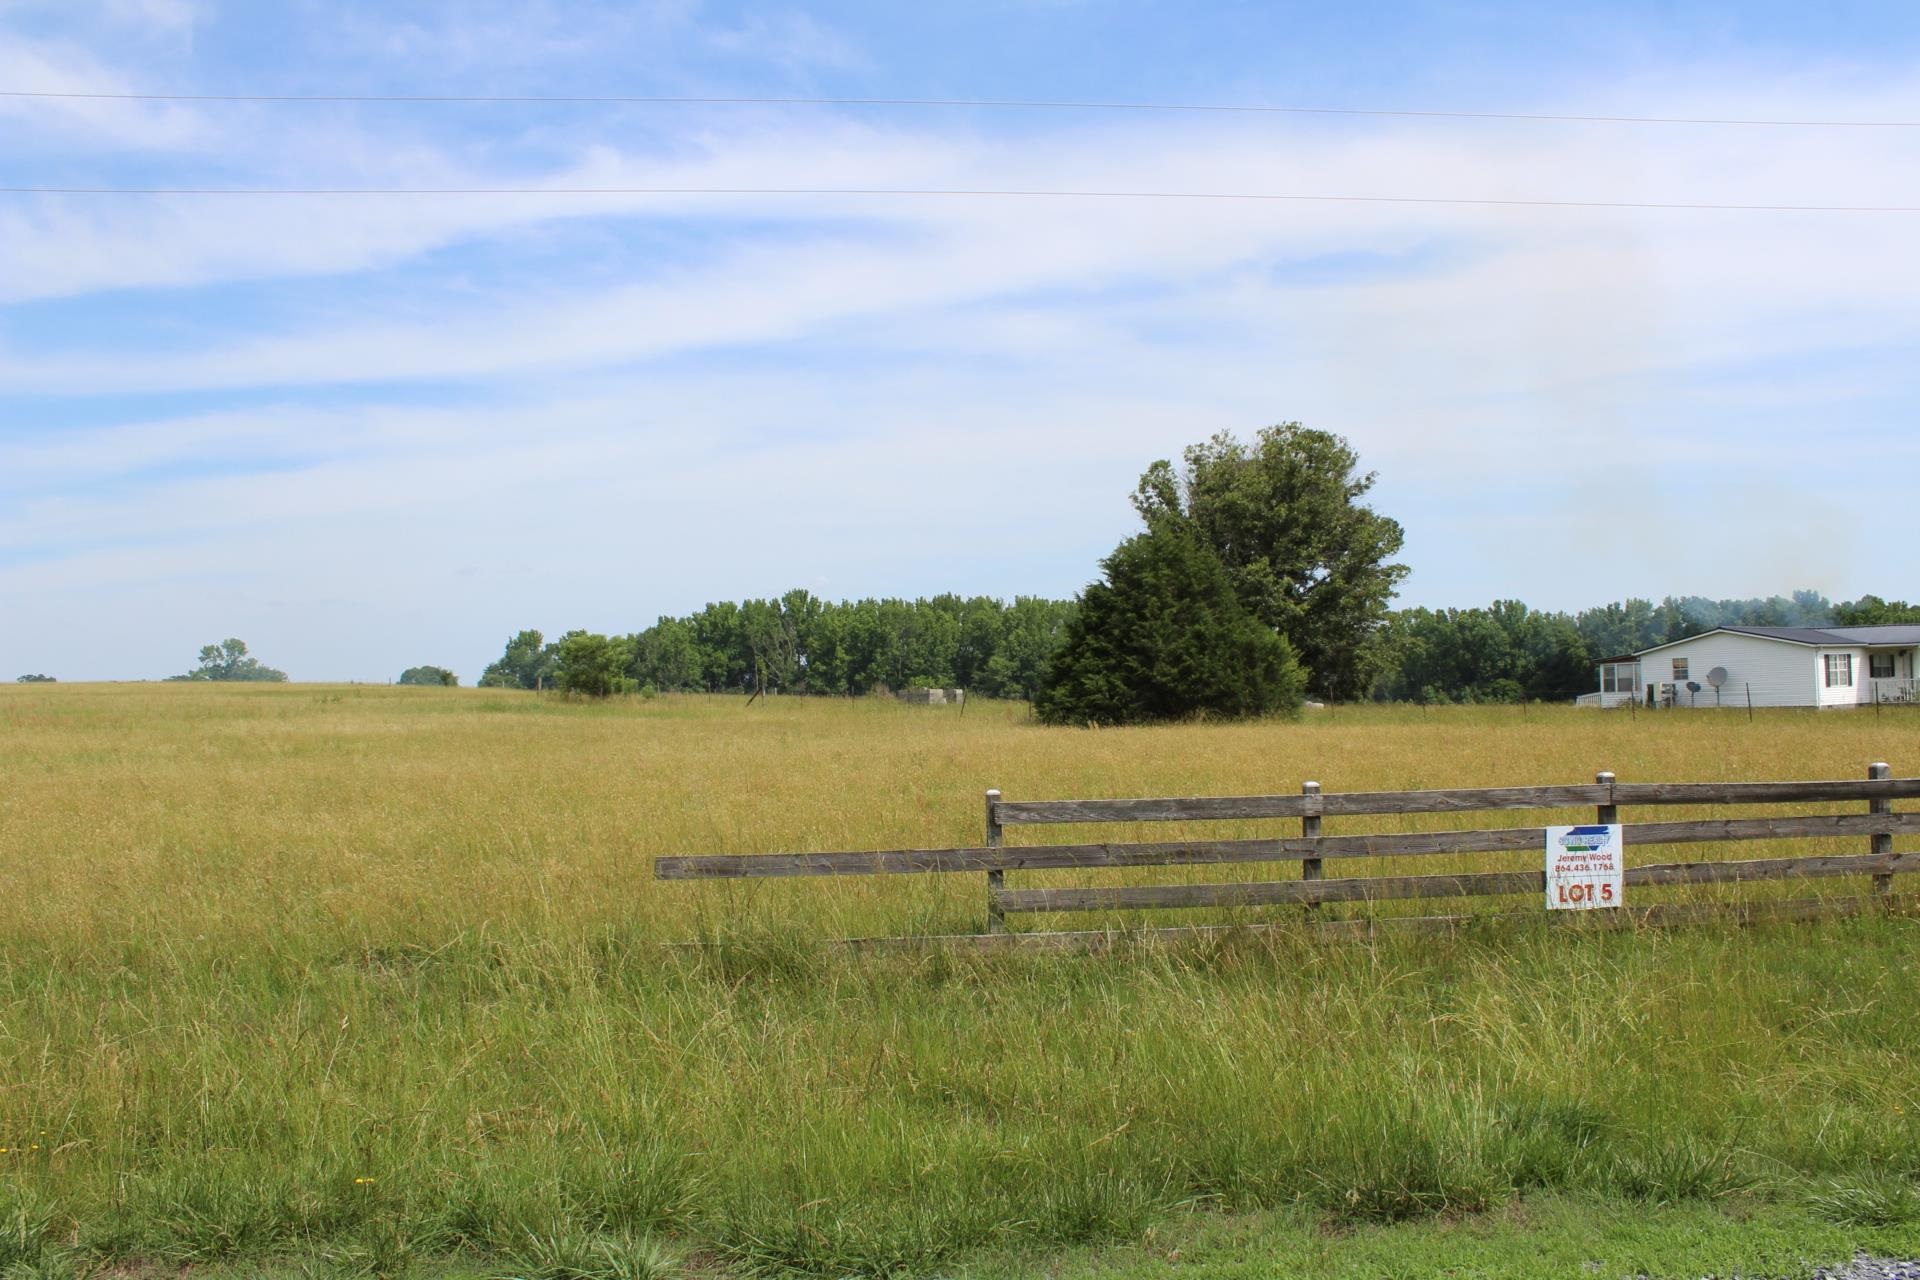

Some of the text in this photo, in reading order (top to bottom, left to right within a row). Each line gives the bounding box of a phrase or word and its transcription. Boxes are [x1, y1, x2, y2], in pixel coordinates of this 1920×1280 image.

[1558, 853, 1612, 862] Jeremy Wood
[1558, 884, 1613, 902] LOT 5
